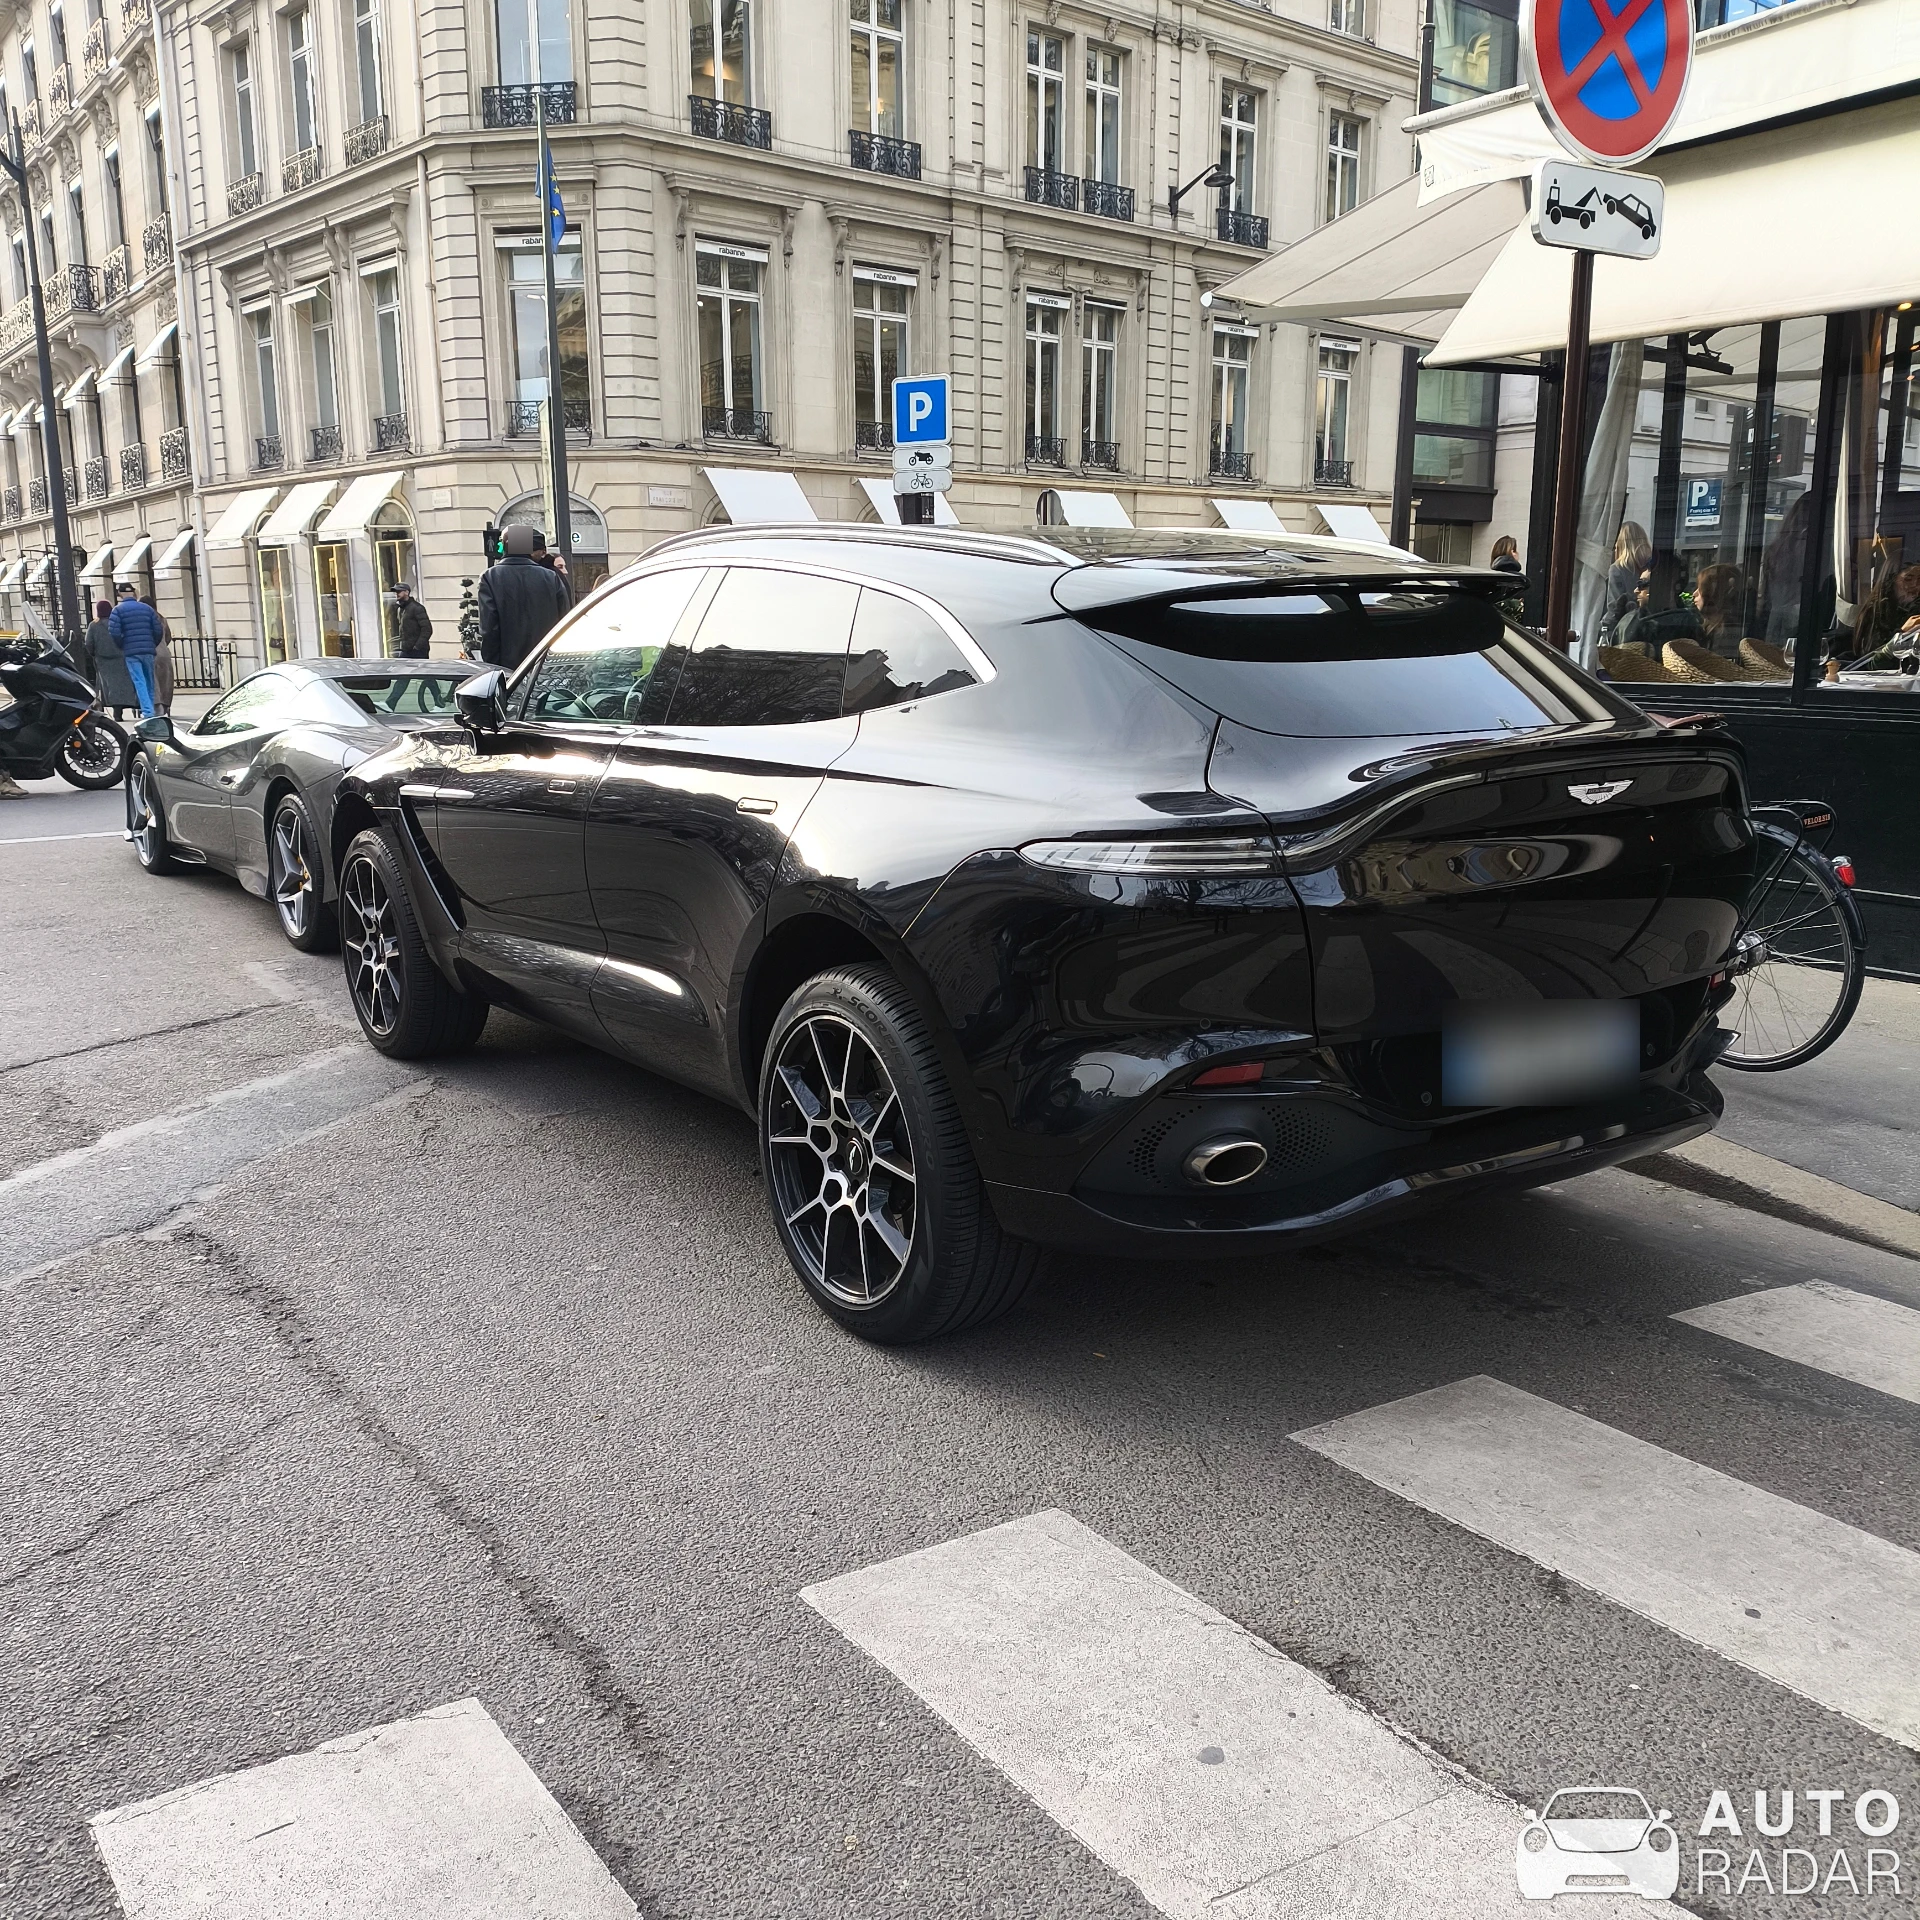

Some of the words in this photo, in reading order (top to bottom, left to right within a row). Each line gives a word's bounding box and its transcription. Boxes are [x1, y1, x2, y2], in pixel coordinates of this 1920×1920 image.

[719, 247, 745, 257] rabanne
[873, 272, 897, 281] rabanne
[909, 391, 933, 432] P
[1691, 481, 1709, 507] P
[848, 995, 914, 1086] SCORPION
